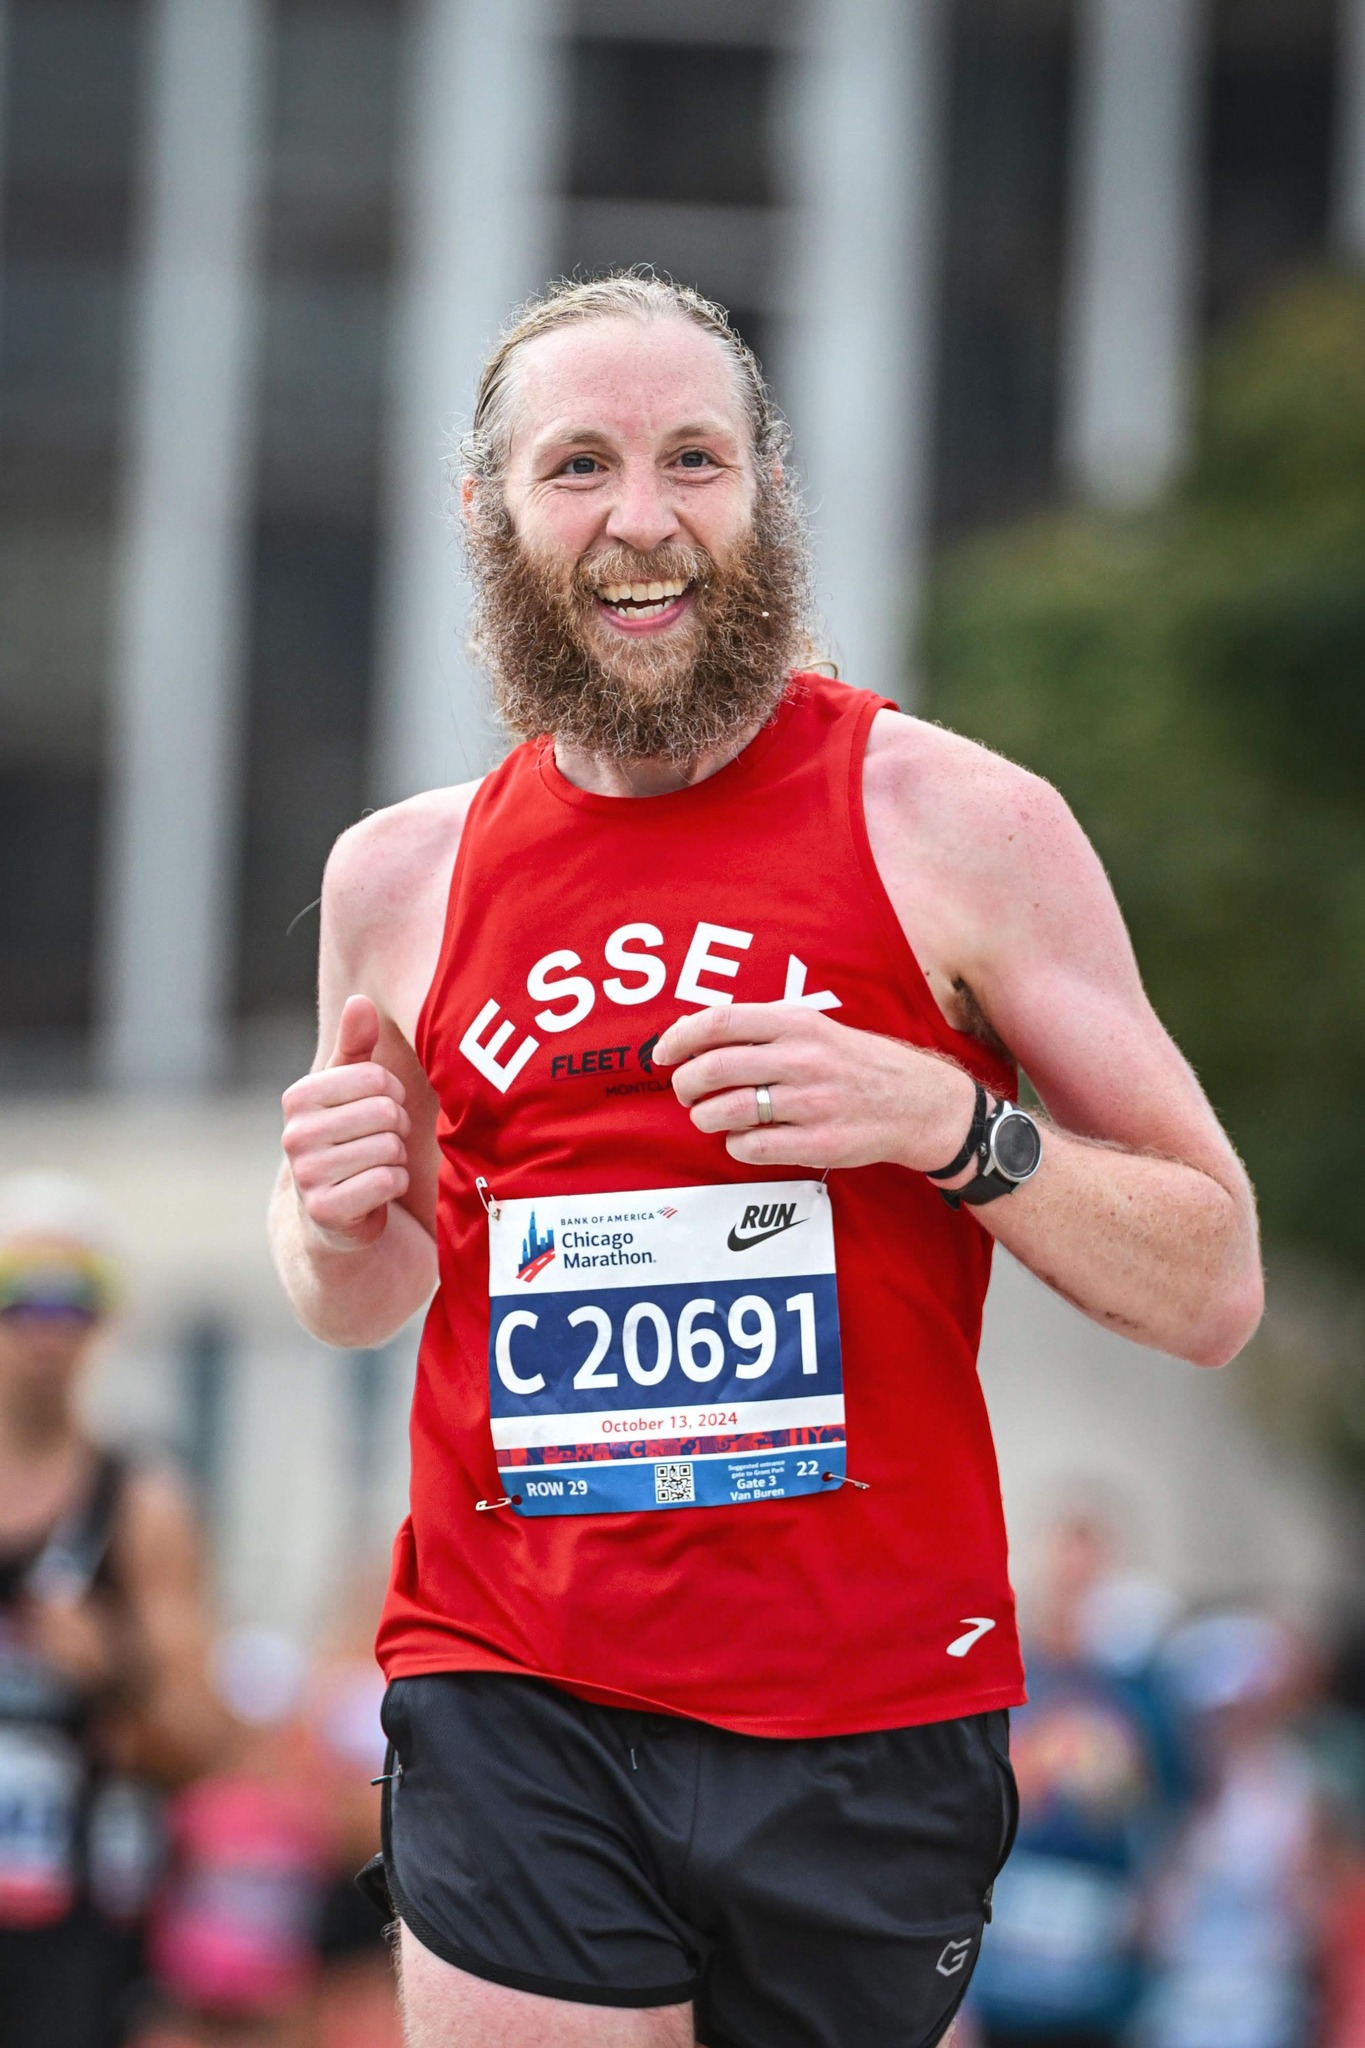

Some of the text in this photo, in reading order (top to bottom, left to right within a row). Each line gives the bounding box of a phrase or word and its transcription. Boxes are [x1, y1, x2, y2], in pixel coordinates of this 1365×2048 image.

[551, 1046, 631, 1078] FLEET
[606, 1078, 673, 1097] MONTCLA
[560, 1212, 655, 1226] BANK OF AMERICA
[740, 1203, 797, 1229] RUN
[562, 1231, 634, 1250] Chicago
[495, 1292, 818, 1395] C 20691
[601, 1412, 738, 1433] October 13, 2024
[796, 1460, 819, 1476] 22
[525, 1480, 588, 1497] ROW 29
[737, 1475, 777, 1489] Gate 3
[730, 1488, 785, 1501] Van Buren
